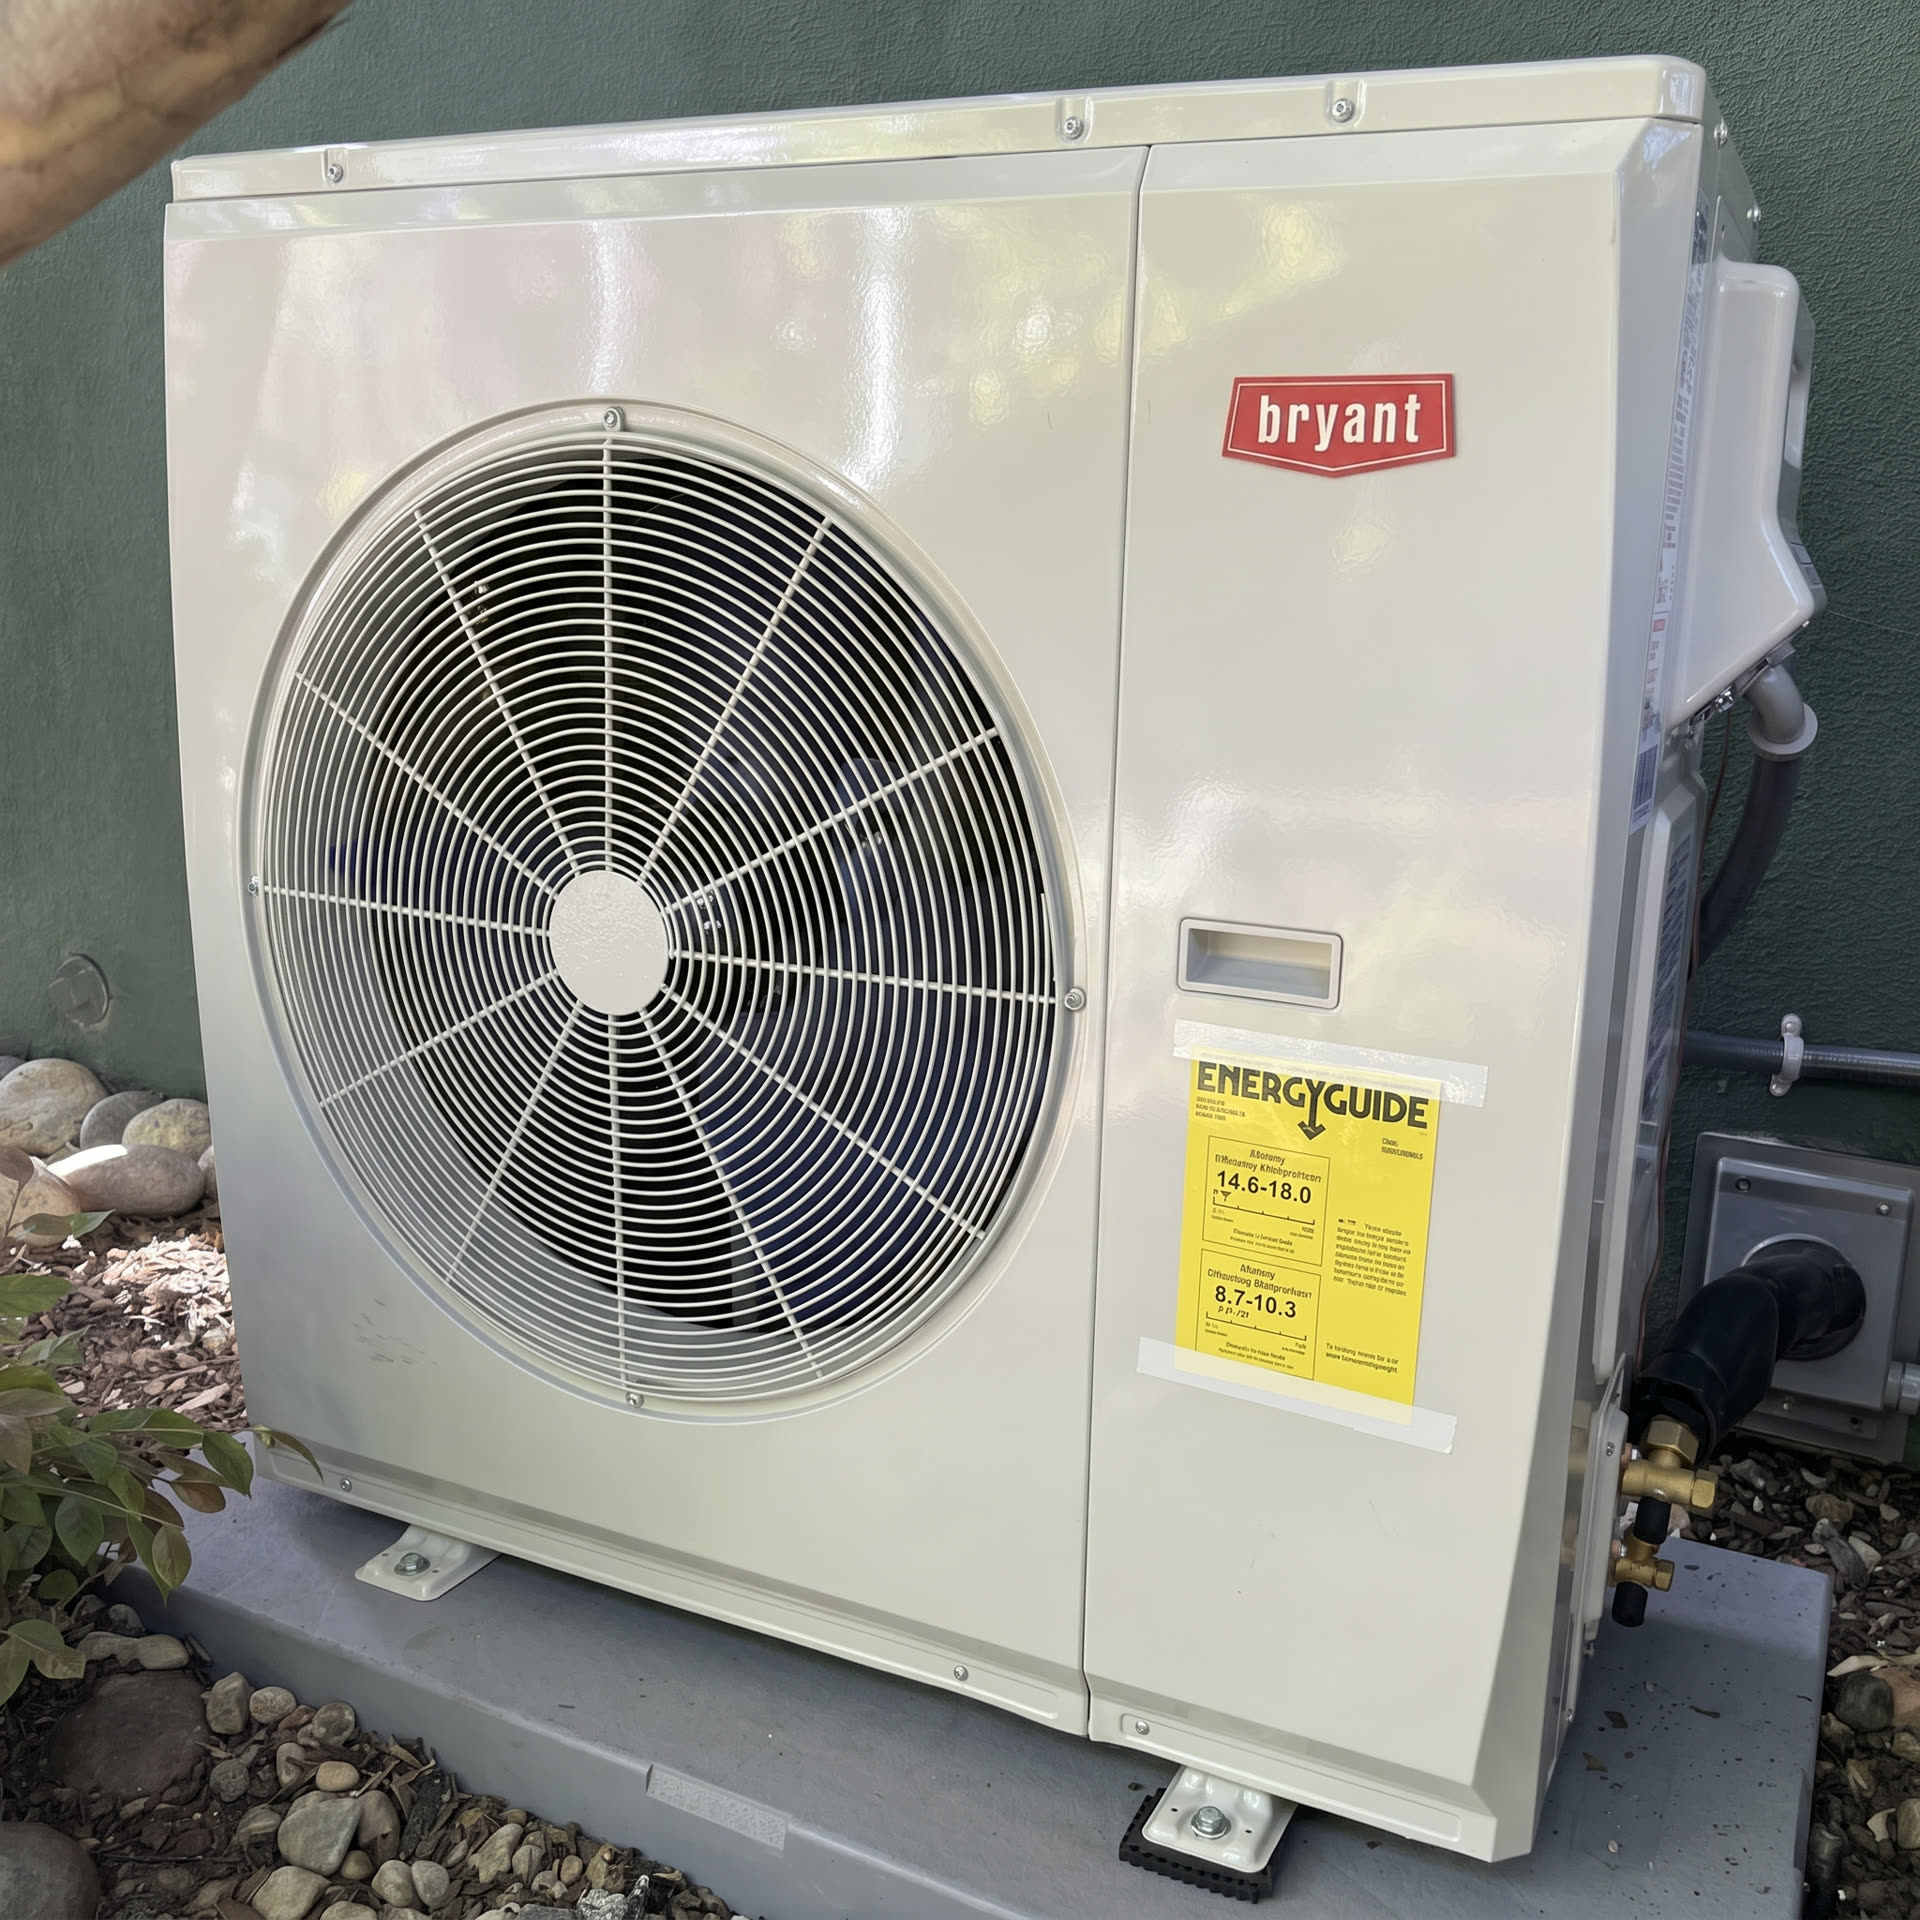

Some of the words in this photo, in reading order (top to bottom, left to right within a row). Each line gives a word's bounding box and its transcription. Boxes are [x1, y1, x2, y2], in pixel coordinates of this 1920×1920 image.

[1257, 394, 1421, 452] bryant
[1217, 1170, 1312, 1204] 14.6-18.0
[1215, 1285, 1297, 1318] 8.7-10.3
